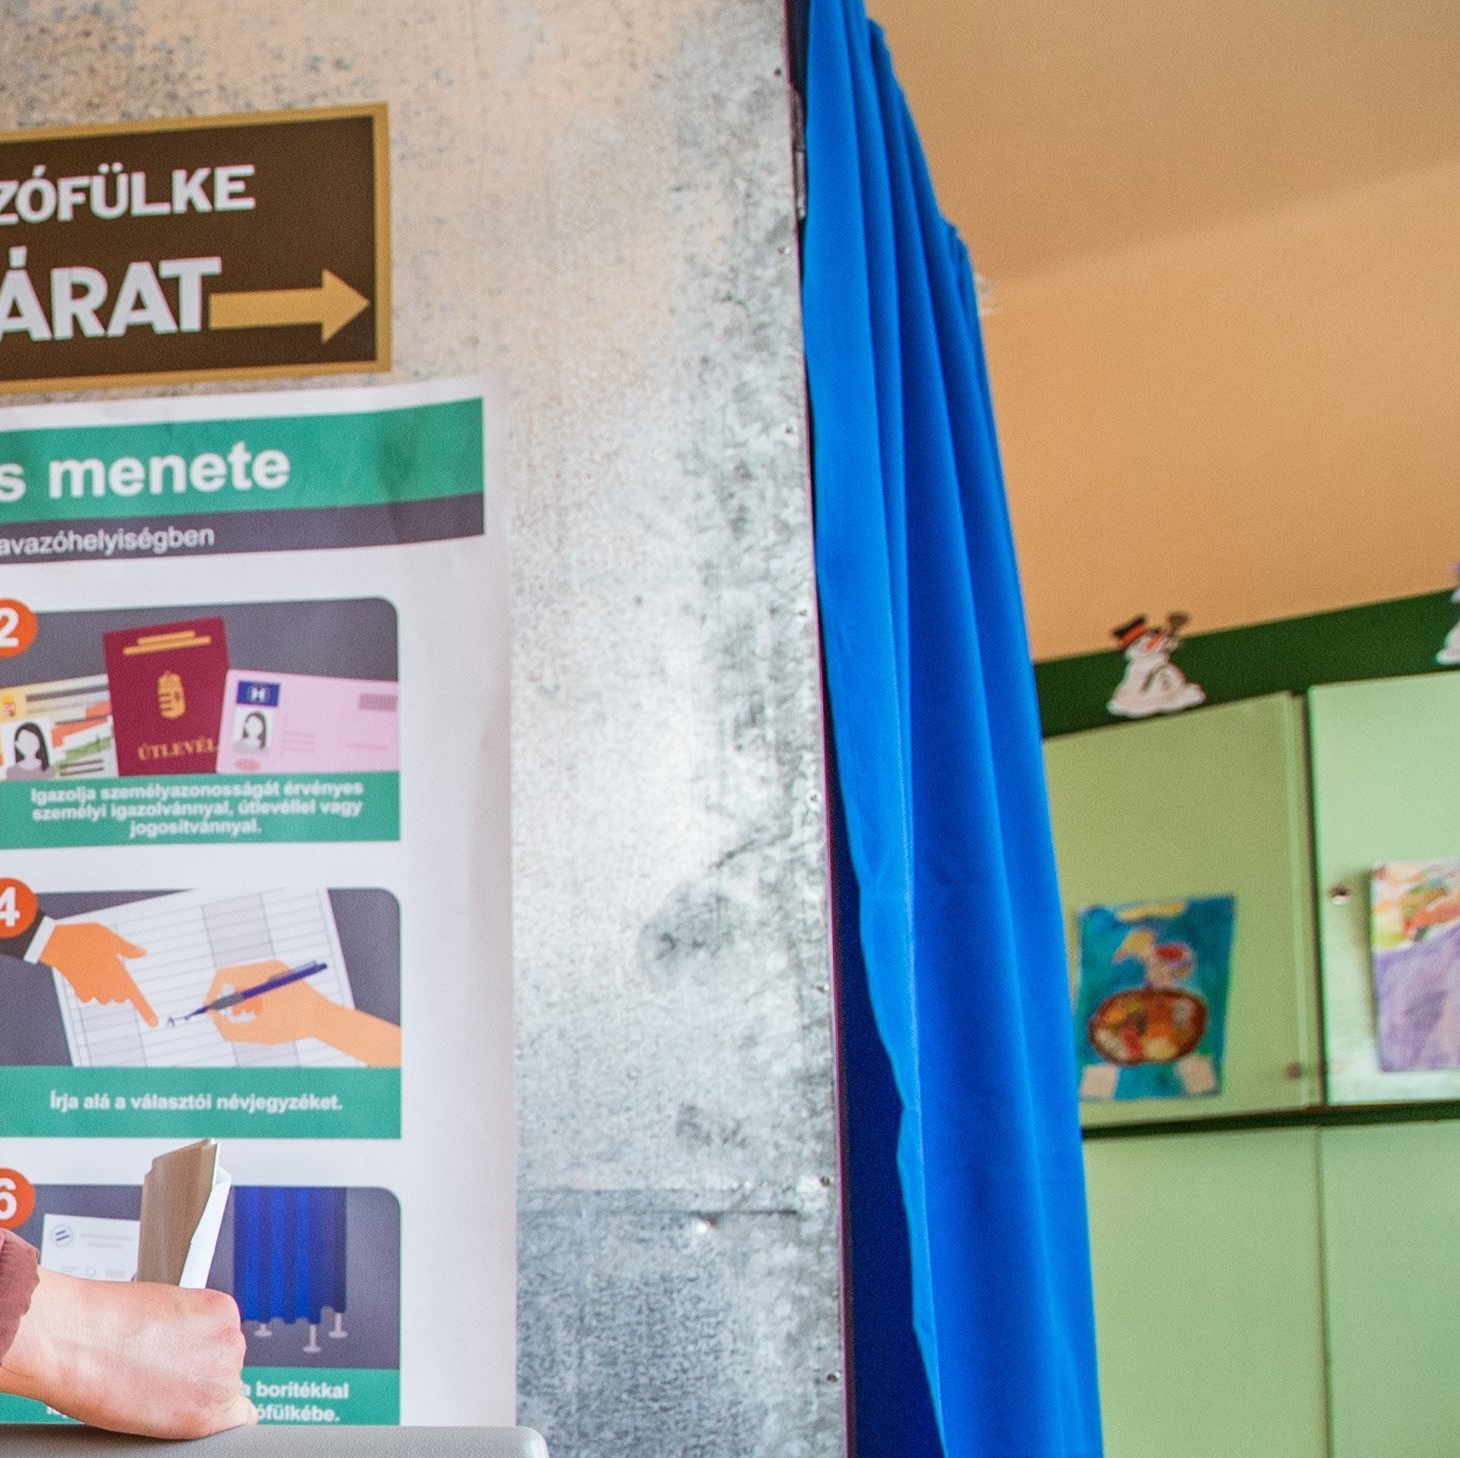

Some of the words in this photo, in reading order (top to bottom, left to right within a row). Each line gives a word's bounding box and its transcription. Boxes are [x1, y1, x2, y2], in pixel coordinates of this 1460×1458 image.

[48, 441, 291, 498] menete
[31, 786, 96, 804] Igazolja
[100, 780, 279, 802] személyazonosságát
[283, 779, 363, 800] érvényes
[33, 803, 106, 822] személyi
[111, 801, 234, 820] igazolvánnyal,
[238, 798, 315, 815] útlevéllel
[320, 799, 362, 818] vagy
[129, 819, 261, 839] jogosítvánnyal.
[50, 1090, 78, 1111] Írja
[84, 1093, 110, 1110] alá
[115, 1096, 126, 1110] a
[131, 1092, 211, 1110] választói
[216, 1092, 342, 1112] névjegyzéket.
[256, 1381, 349, 1399] borítékkal
[256, 1404, 340, 1422] ófülkébe.
